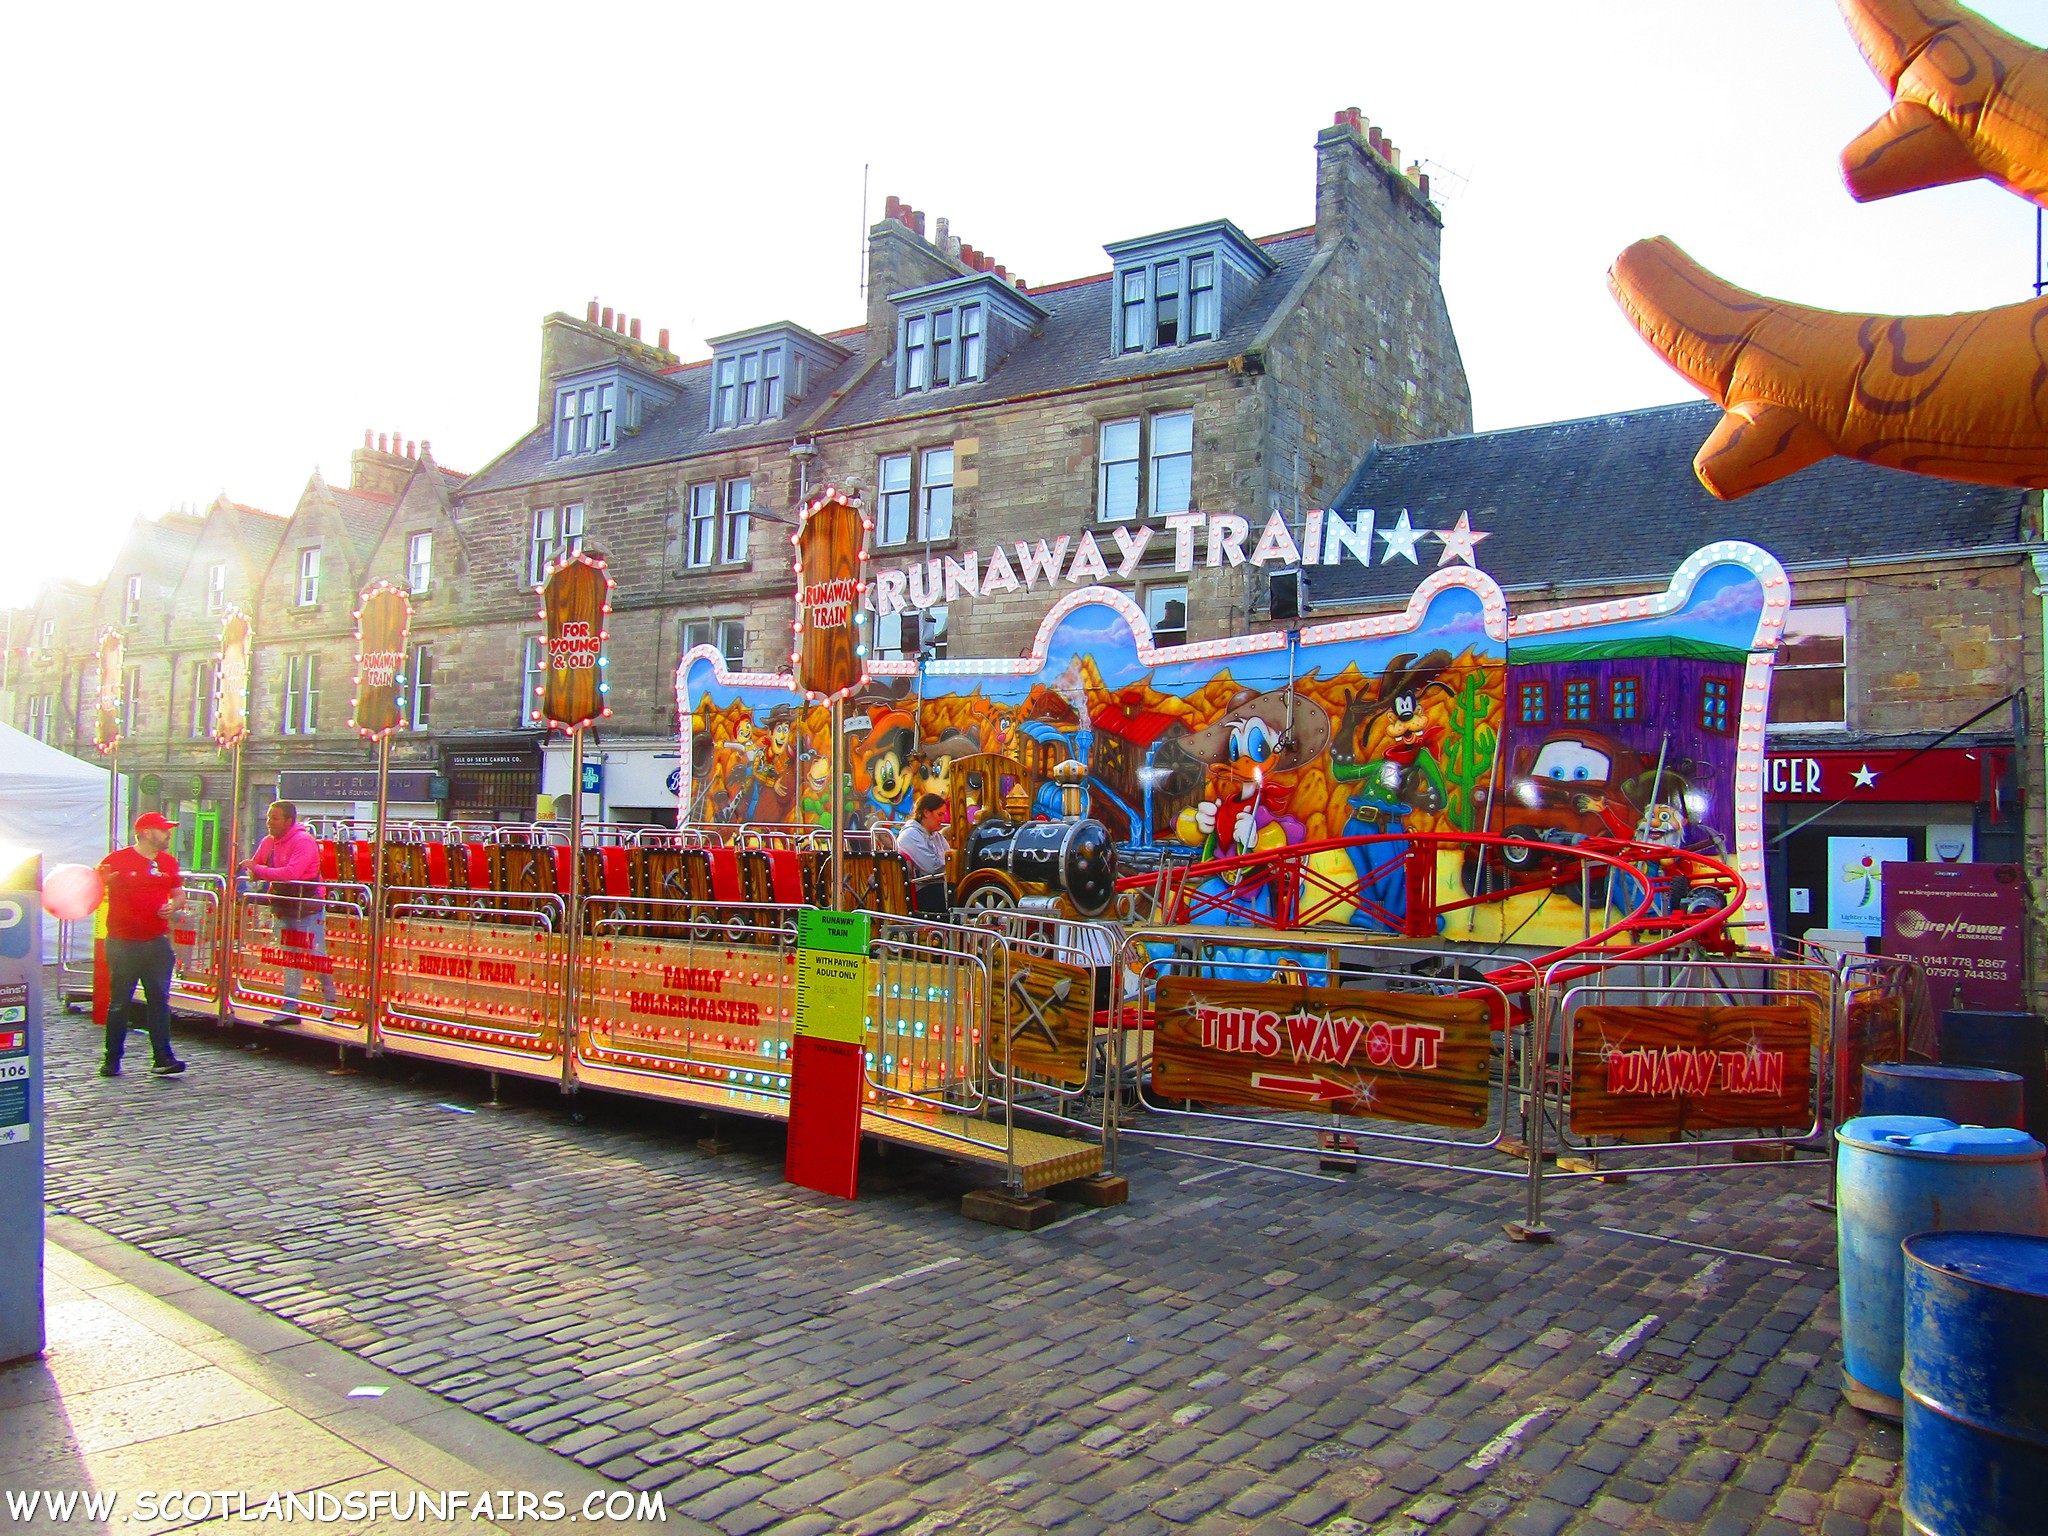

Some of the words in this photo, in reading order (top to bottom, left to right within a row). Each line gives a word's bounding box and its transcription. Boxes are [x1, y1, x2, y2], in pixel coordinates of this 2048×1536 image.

[875, 524, 1156, 616] RUNAWAY
[1164, 508, 1375, 573] TRAIN
[804, 578, 858, 609] RUNAWAY
[813, 604, 848, 629] TRAIN
[562, 622, 590, 638] FOR
[549, 636, 601, 655] YOUNG
[362, 650, 400, 671] RUNAWAY
[552, 655, 567, 670] &
[567, 653, 596, 669] OLD
[367, 668, 394, 688] TRAIN
[1898, 889, 1998, 898] www.hirepowergenerators.co.uk
[821, 915, 855, 926] RUNAWAY
[1914, 920, 1945, 932] Hire
[1957, 922, 2006, 935] Power
[827, 928, 848, 937] TRAIN
[1956, 933, 2003, 941] GENERATORS
[418, 954, 473, 977] RUNAWAY
[478, 960, 517, 984] TRAIN
[815, 956, 833, 966] WITH
[833, 958, 859, 969] PAYING
[1922, 955, 1948, 965] 0141
[1951, 956, 1972, 966] 778
[1977, 958, 2007, 968] 2867
[663, 966, 724, 993] FAMILY
[816, 968, 838, 978] ADULT
[838, 970, 857, 980] ONLY
[1926, 967, 1960, 977] 07973
[1963, 969, 2008, 980] 744353
[0, 985, 27, 995] oins?
[629, 991, 760, 1026] ROLLERCOASTER
[1196, 1005, 1282, 1057] THIS
[1285, 1007, 1365, 1068] WAY
[1366, 1020, 1445, 1070] OUT
[813, 1043, 828, 1053] TOO
[1607, 1045, 1717, 1099] RUNAWAY
[1718, 1048, 1783, 1098] TRAIN
